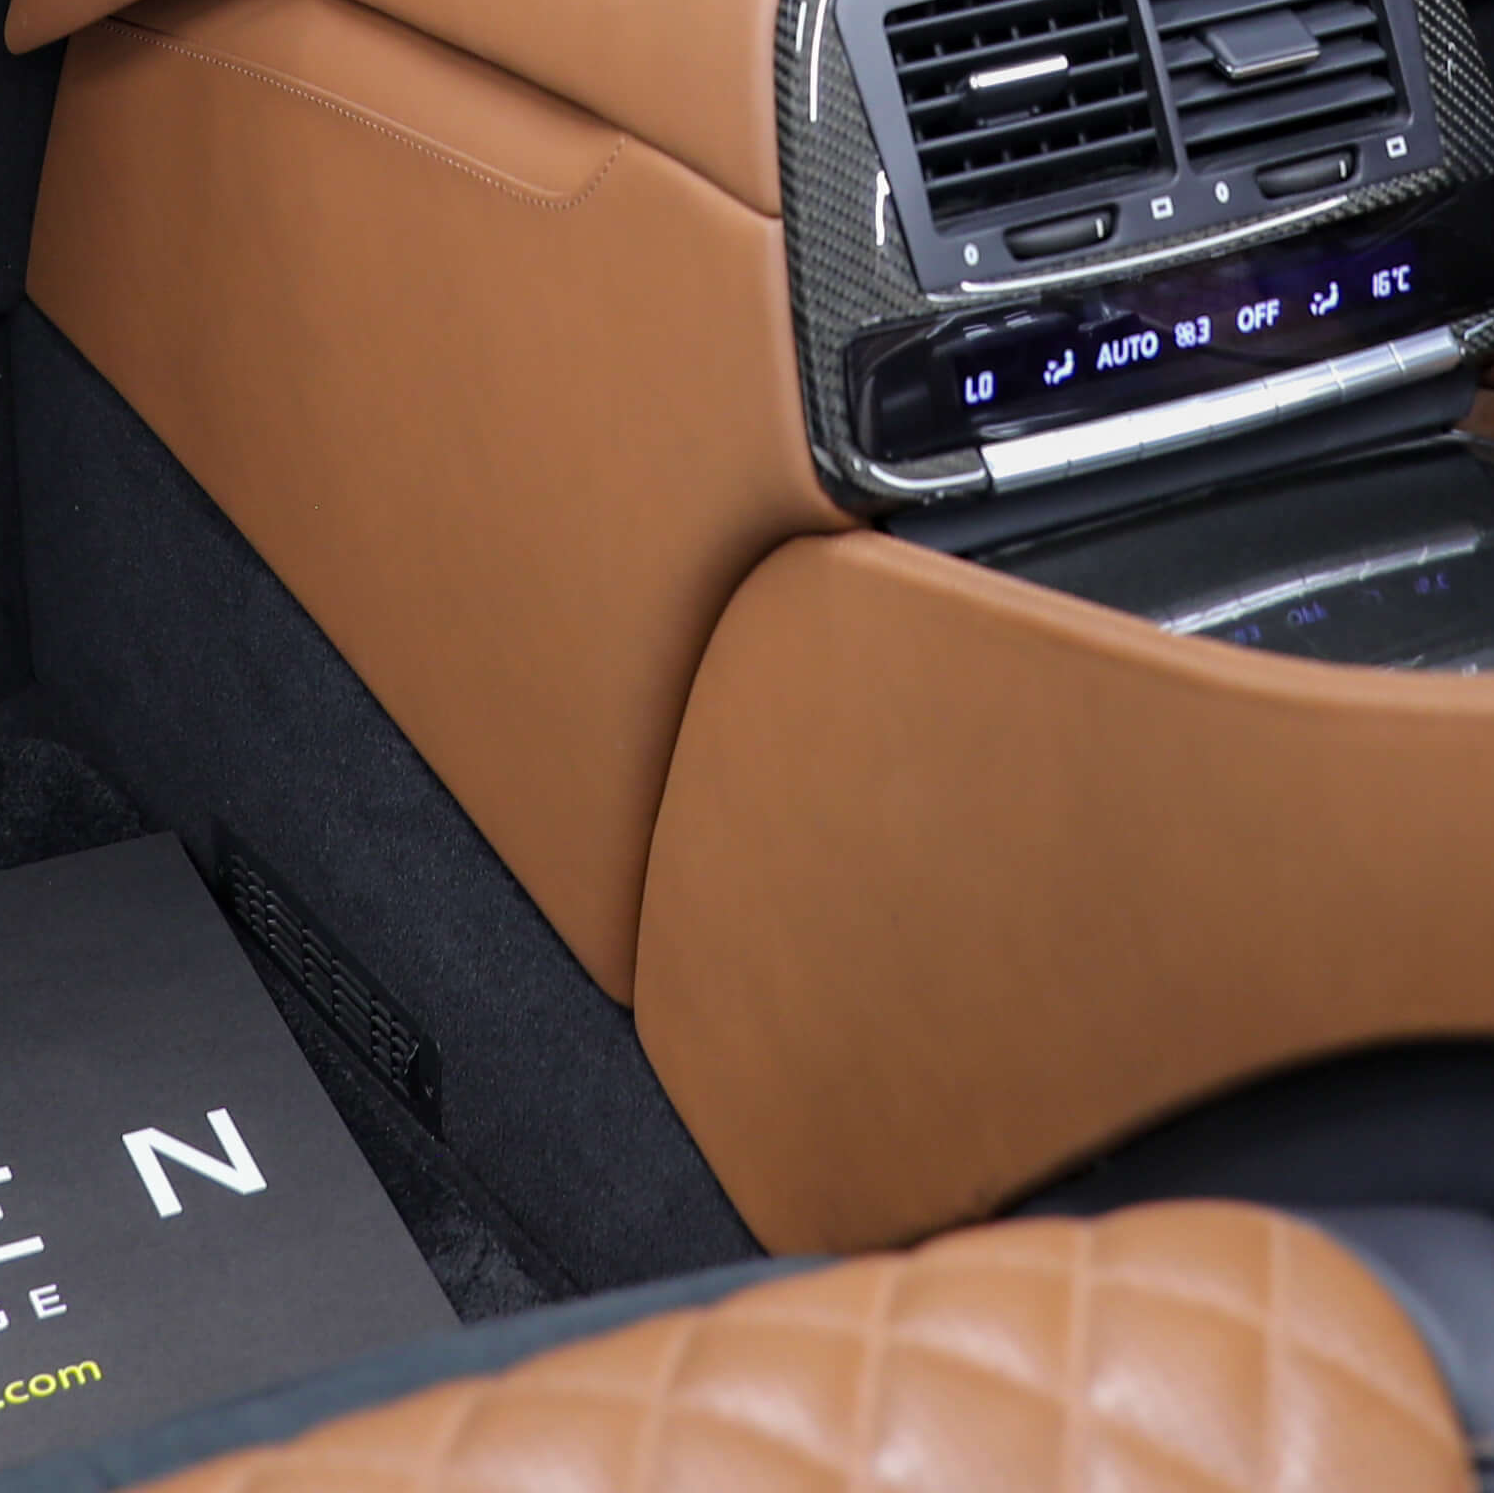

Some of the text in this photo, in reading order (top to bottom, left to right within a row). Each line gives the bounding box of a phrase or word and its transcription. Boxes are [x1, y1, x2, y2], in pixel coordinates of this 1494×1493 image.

[964, 370, 995, 404] LO
[1095, 329, 1160, 370] AUTO
[1236, 298, 1281, 334] OFF
[1371, 264, 1411, 298] 16°C
